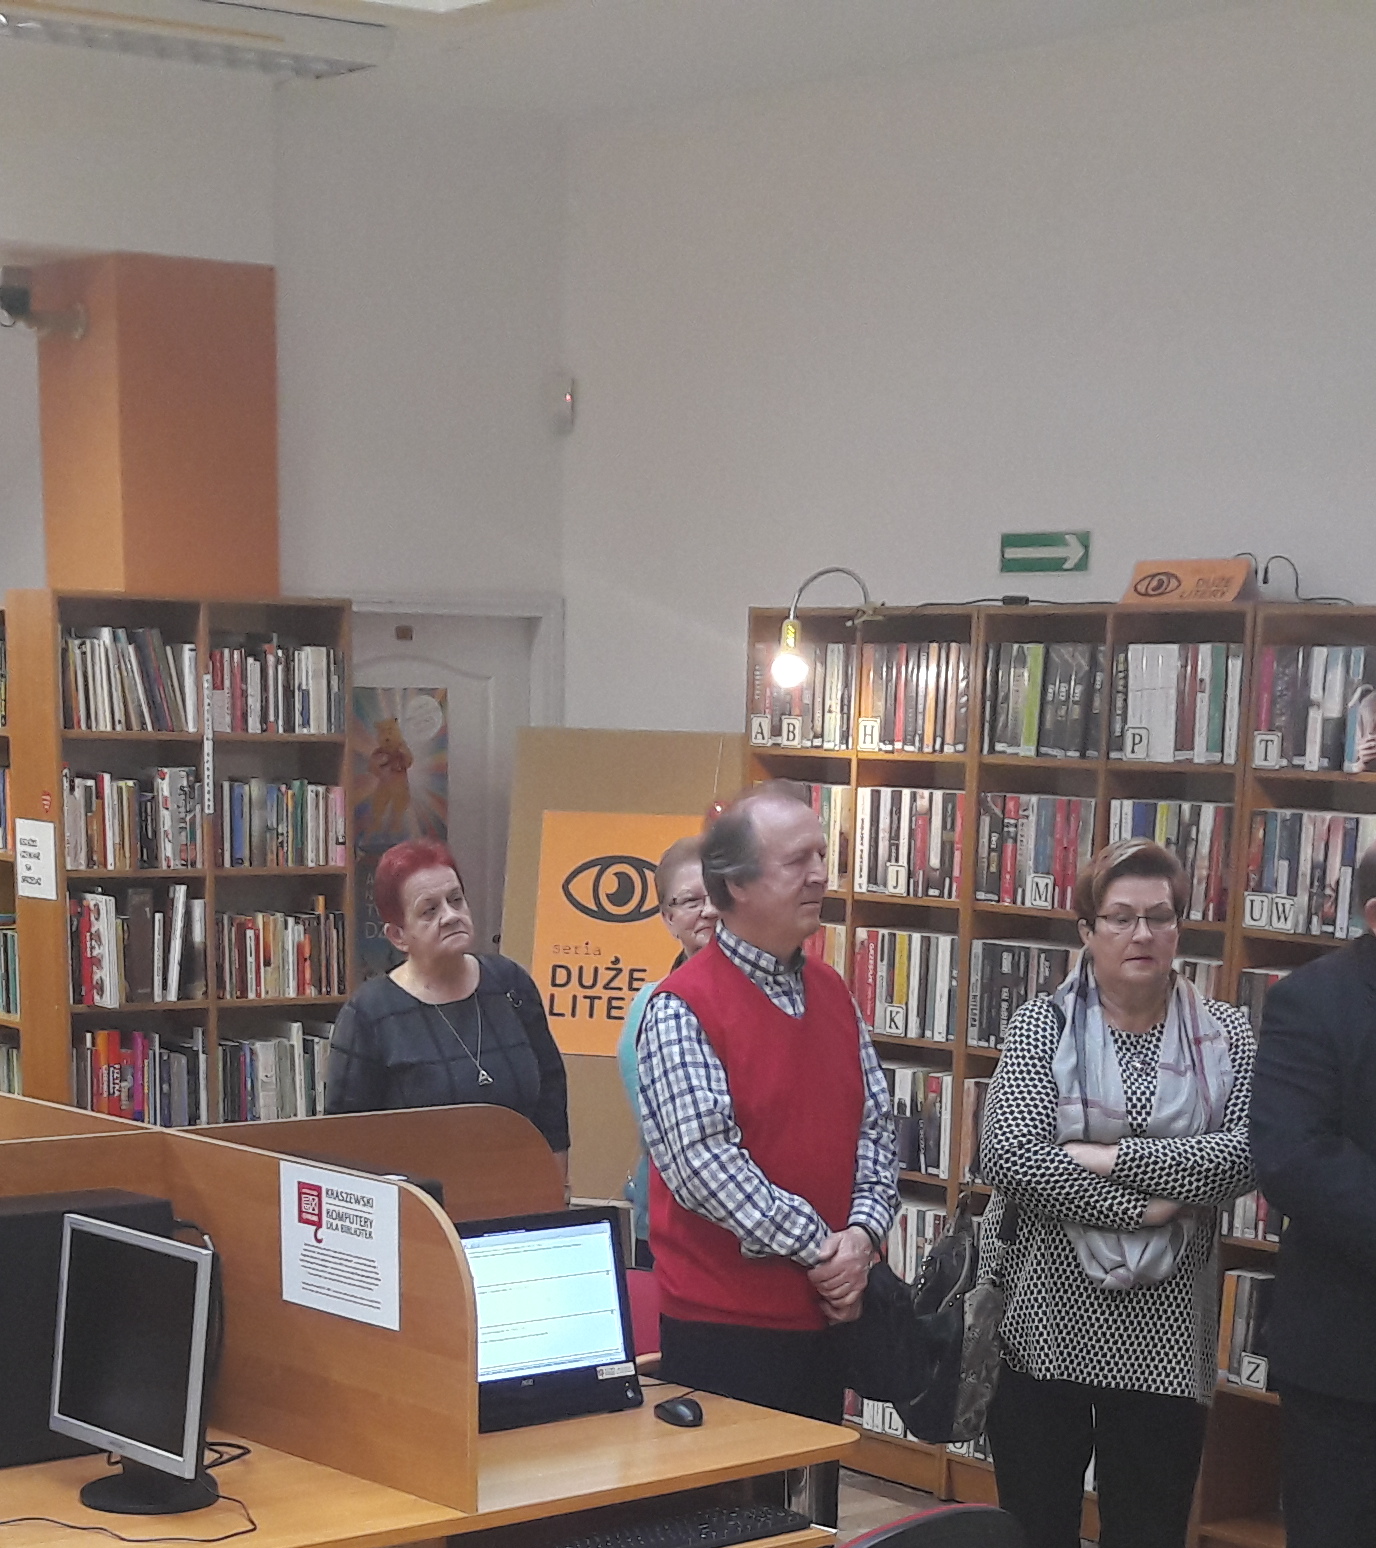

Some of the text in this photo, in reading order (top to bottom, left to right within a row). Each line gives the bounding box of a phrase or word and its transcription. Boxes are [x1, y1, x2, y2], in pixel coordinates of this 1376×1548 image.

[754, 721, 766, 740] A
[786, 722, 797, 738] B
[863, 724, 875, 745] H
[1130, 732, 1143, 754] P
[1259, 739, 1275, 761] T
[891, 868, 900, 889] J
[1032, 881, 1050, 906] M
[1248, 899, 1265, 922] U
[1274, 901, 1295, 923] W
[552, 940, 602, 956] seria
[550, 955, 647, 992] DUŻE
[548, 993, 632, 1020] LITE
[888, 1010, 901, 1031] K
[325, 1187, 374, 1208] KRASZEWSKI
[326, 1208, 374, 1229] KOMPUTERY
[326, 1221, 374, 1240] DLA BIBLIOTEK
